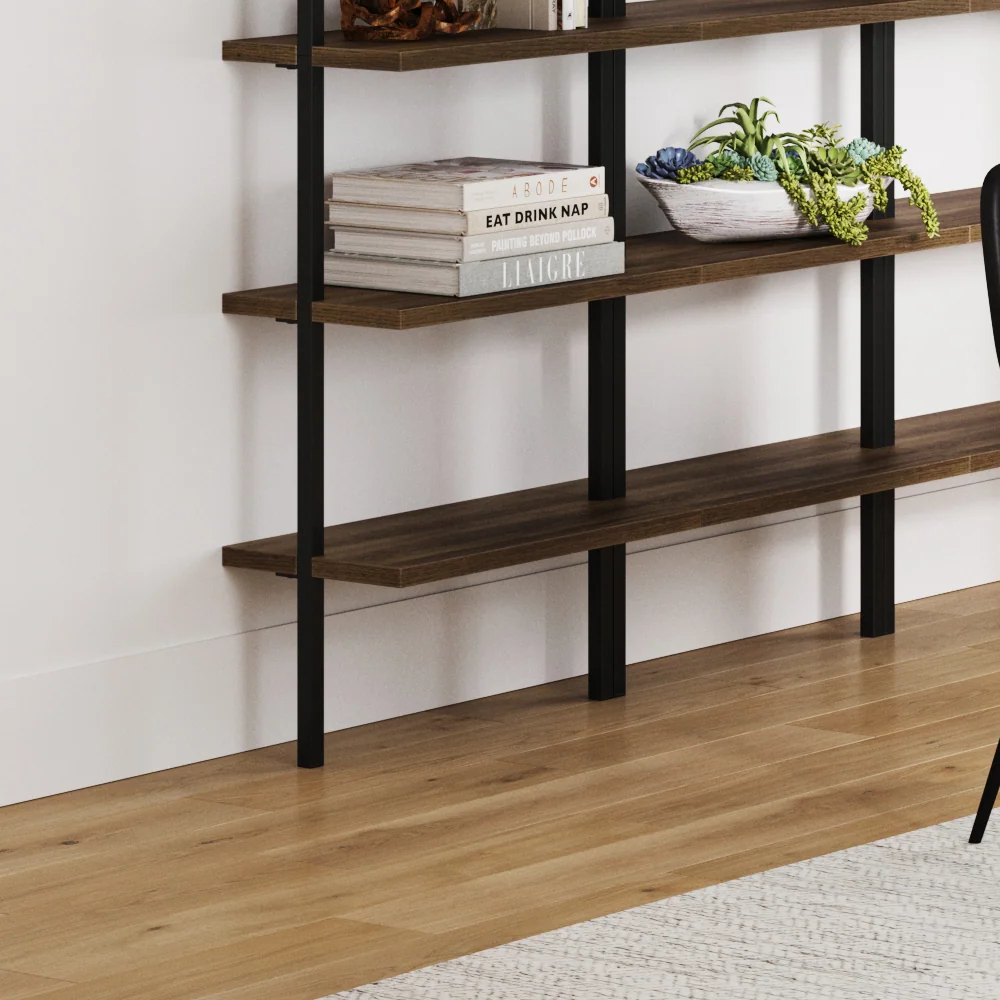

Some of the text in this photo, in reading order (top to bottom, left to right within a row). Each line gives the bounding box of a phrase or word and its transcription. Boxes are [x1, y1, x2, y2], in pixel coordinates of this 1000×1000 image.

[512, 178, 568, 199] ABODE
[486, 213, 511, 229] EAT
[515, 206, 558, 224] DRINK
[561, 202, 589, 218] NAP
[491, 236, 527, 252] PAINTING
[529, 231, 560, 247] BEYOND
[562, 226, 597, 243] POLLOCK
[503, 250, 586, 288] LIAIGRE
